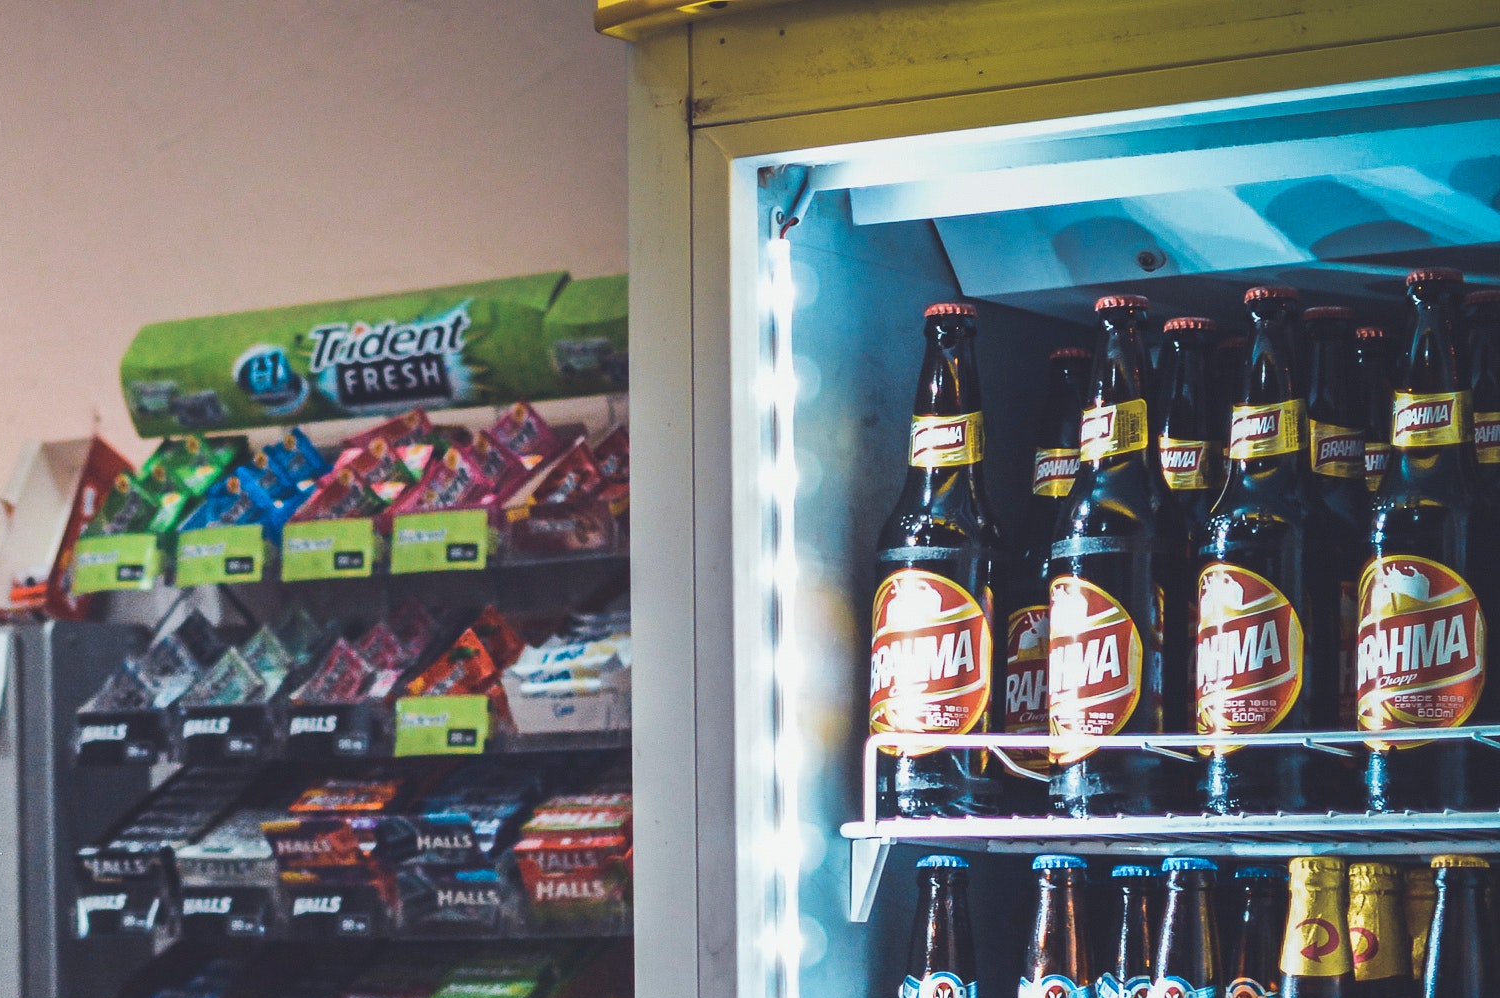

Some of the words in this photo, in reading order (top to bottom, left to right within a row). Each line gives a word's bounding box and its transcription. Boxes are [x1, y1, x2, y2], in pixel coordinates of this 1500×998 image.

[311, 309, 471, 371] Trident
[342, 361, 442, 397] FRESH
[1394, 405, 1450, 430] BRAHMA
[1378, 673, 1418, 688] Chopp
[1231, 712, 1267, 723] 600ml
[1416, 708, 1455, 719] 600ml
[416, 834, 474, 851] HALLS
[437, 889, 500, 907] HALLS
[535, 879, 605, 901] HALLS
